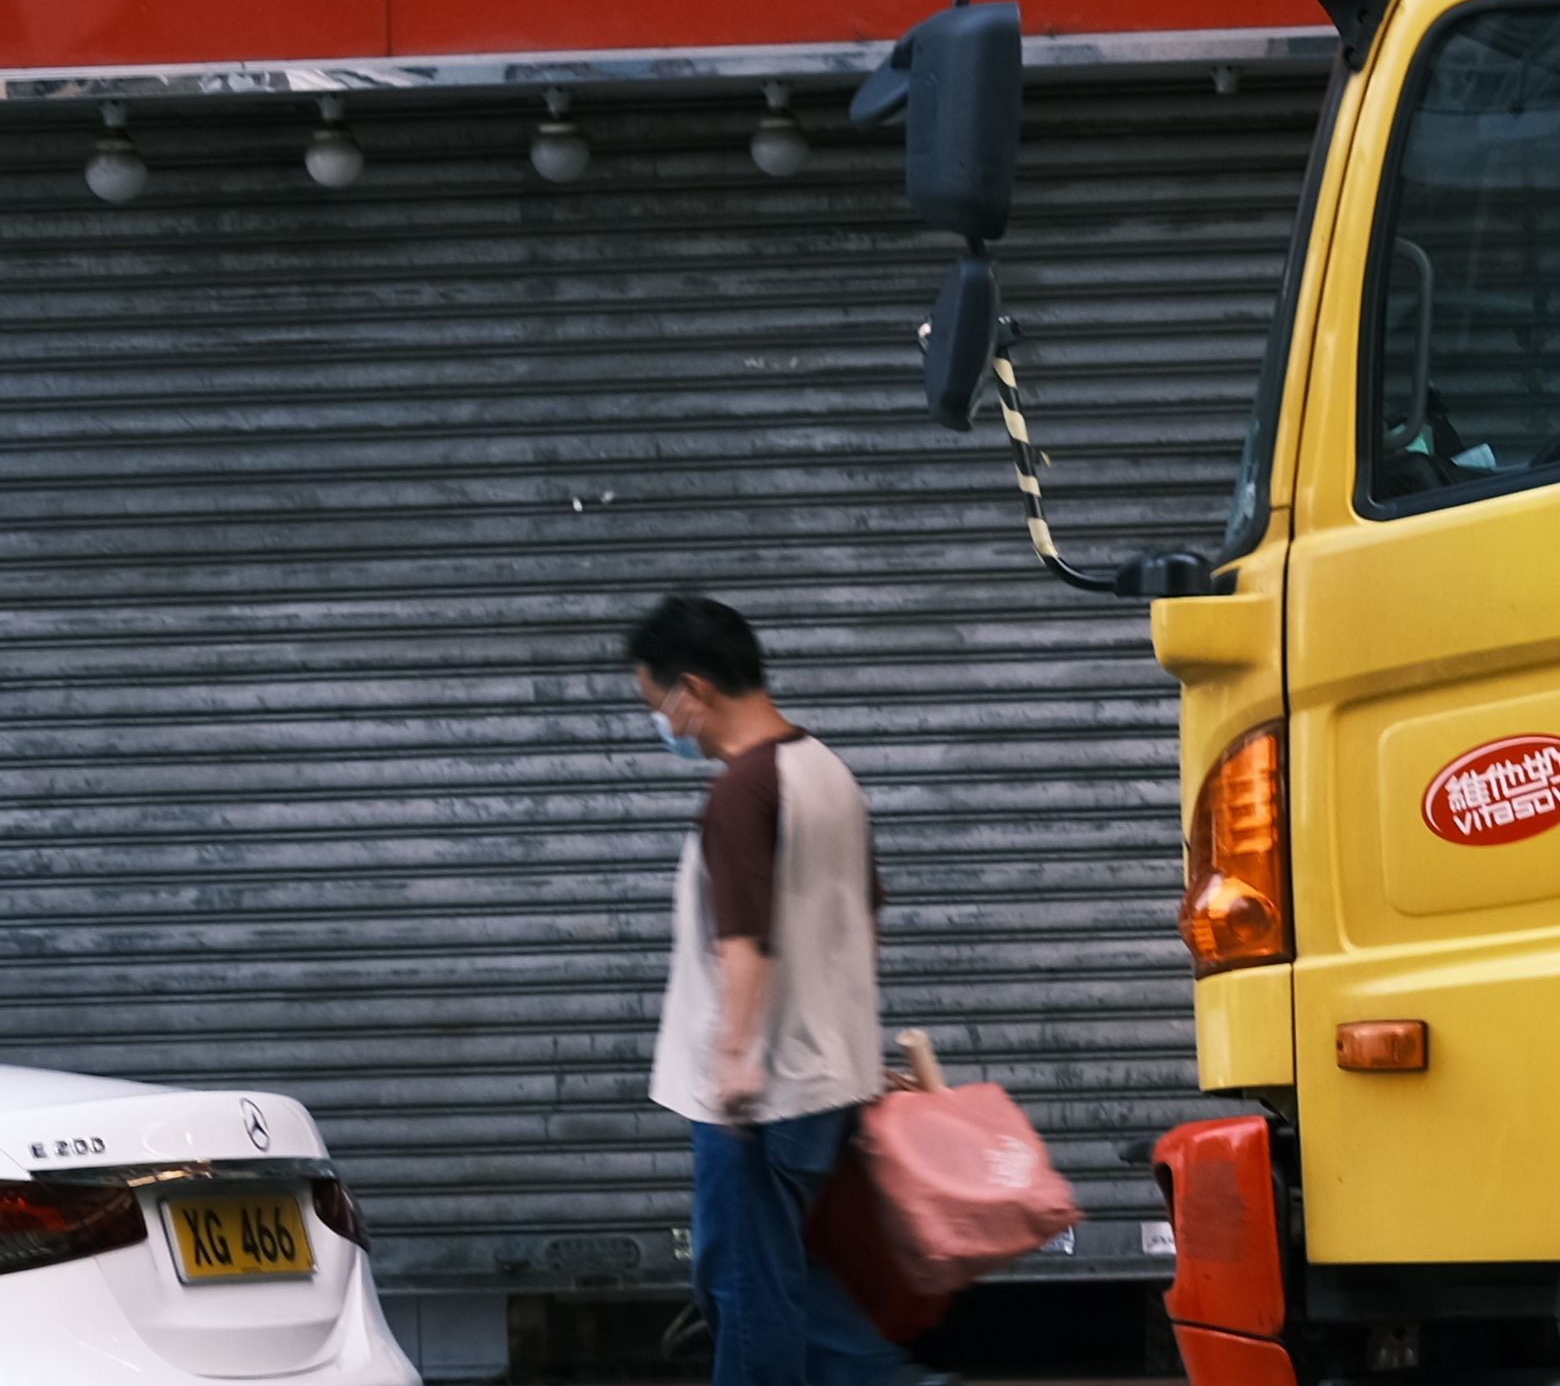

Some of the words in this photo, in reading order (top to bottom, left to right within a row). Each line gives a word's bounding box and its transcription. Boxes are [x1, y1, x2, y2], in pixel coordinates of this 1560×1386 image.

[30, 1143, 47, 1159] E
[55, 1136, 106, 1158] 200
[184, 1208, 234, 1267] XG
[240, 1206, 296, 1266] 466
